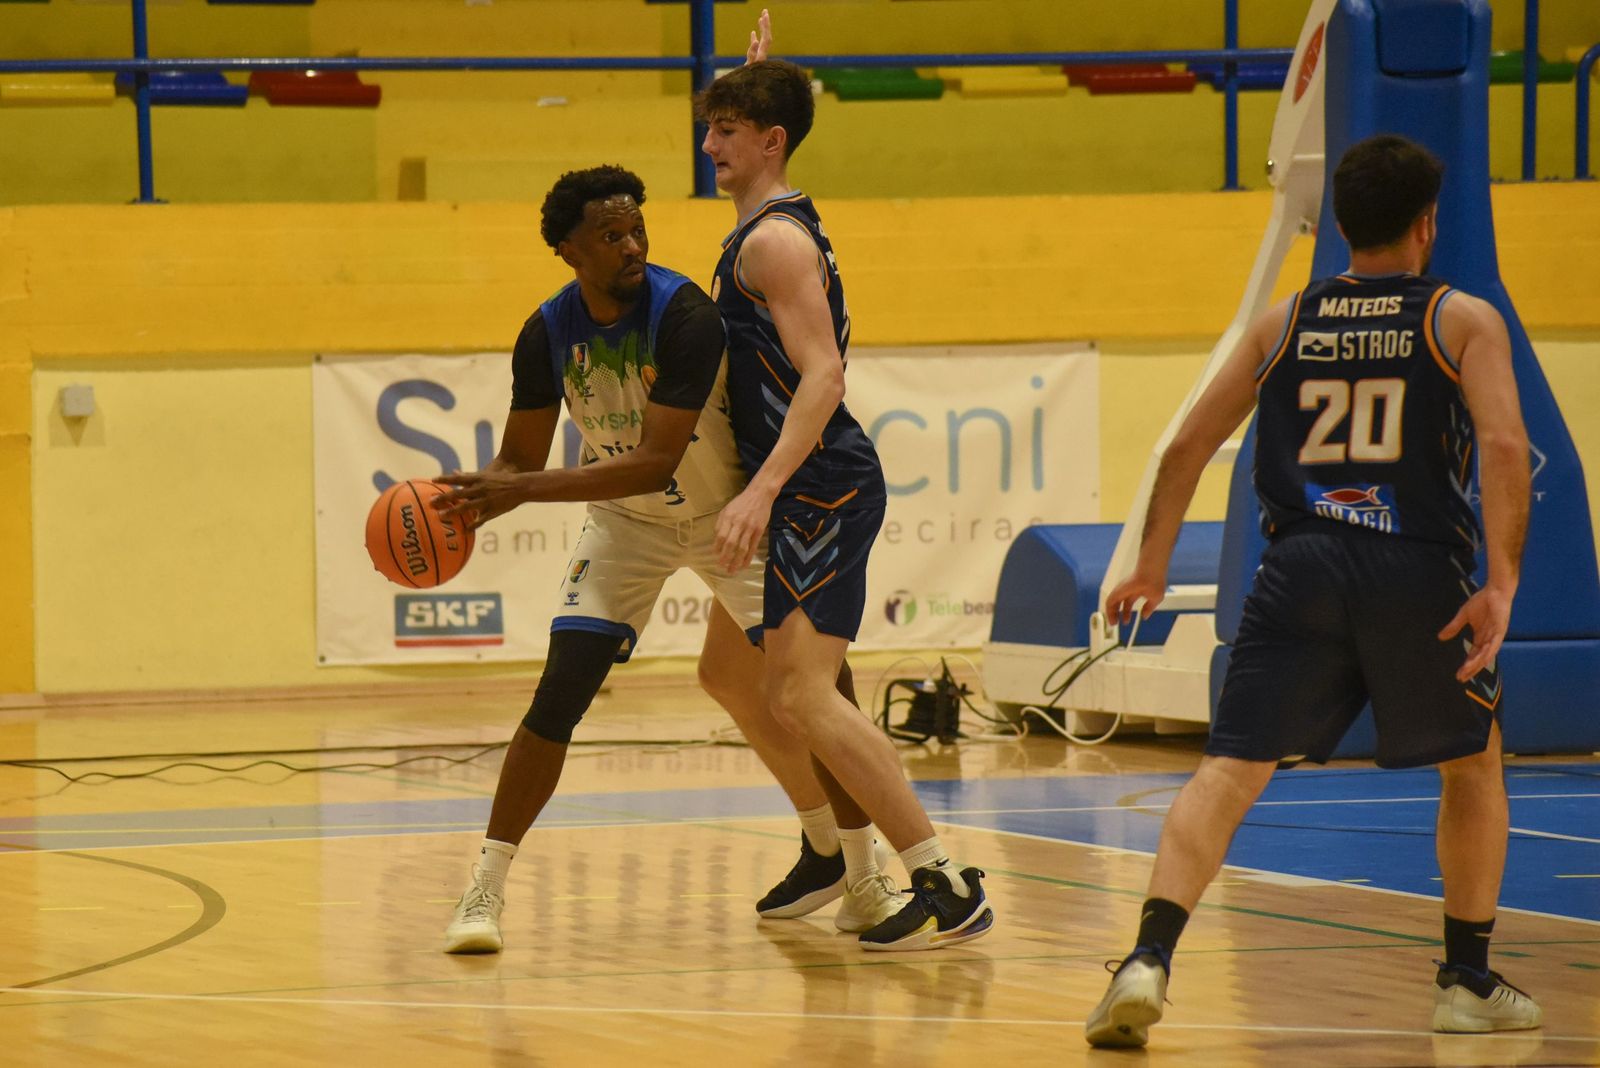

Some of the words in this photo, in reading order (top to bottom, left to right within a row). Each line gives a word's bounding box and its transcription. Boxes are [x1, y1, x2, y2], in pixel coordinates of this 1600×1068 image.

[1318, 296, 1403, 319] MATEOS
[1341, 329, 1414, 361] STROG
[582, 408, 644, 432] BYSPA
[1299, 378, 1407, 464] 20
[400, 505, 429, 577] Wilson
[404, 601, 497, 627] SKF
[927, 600, 994, 616] Telebea
